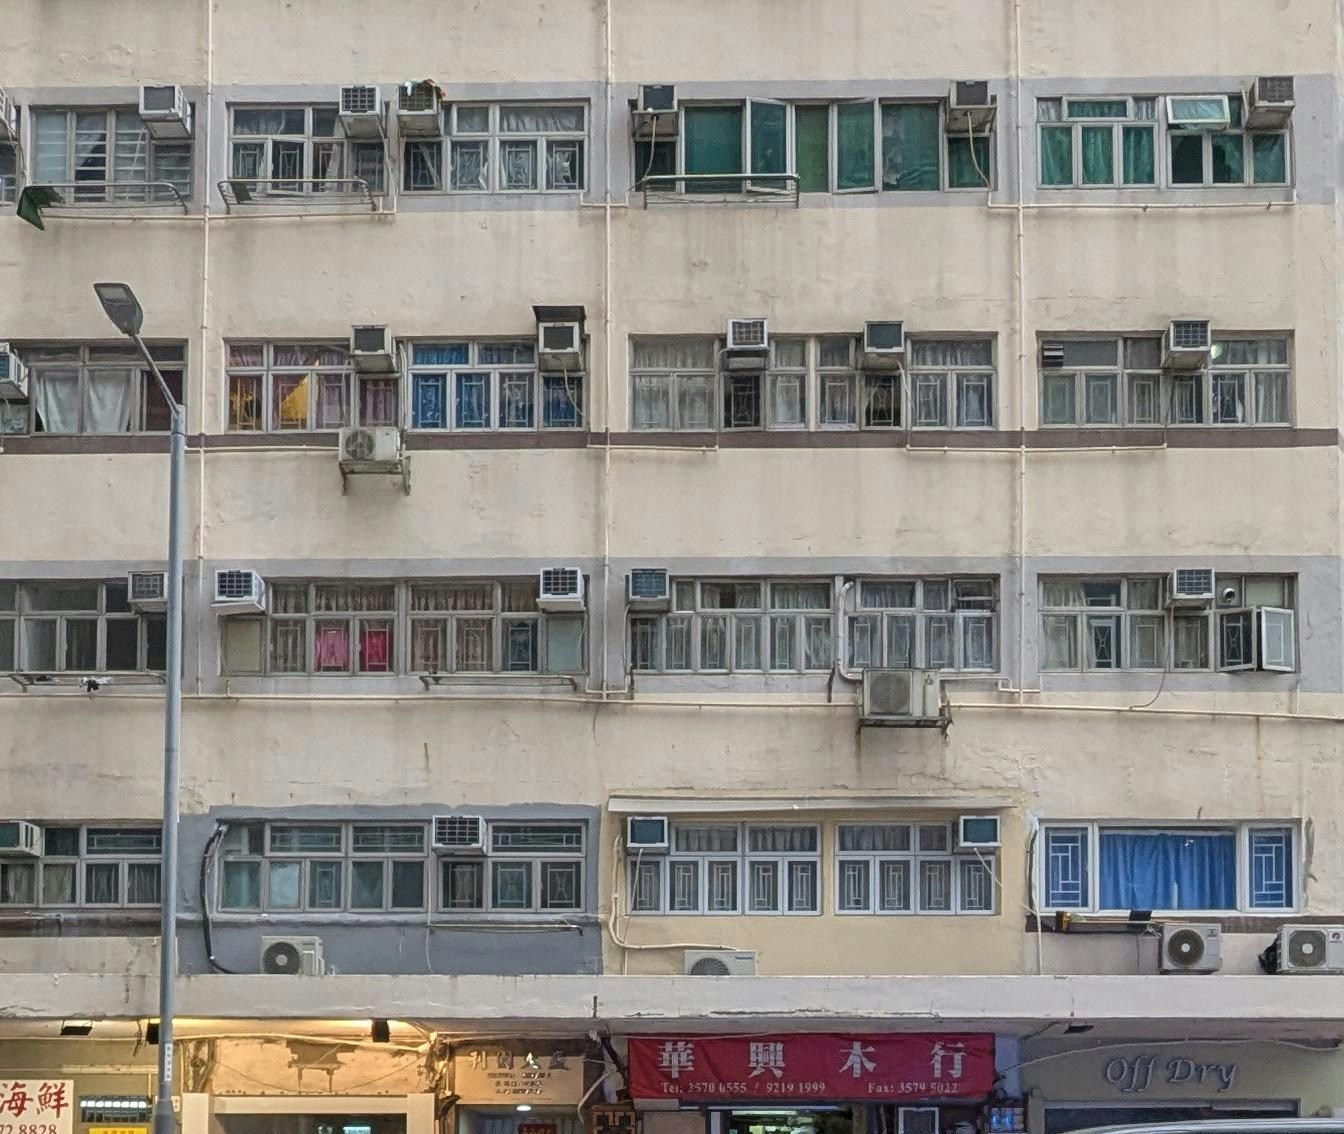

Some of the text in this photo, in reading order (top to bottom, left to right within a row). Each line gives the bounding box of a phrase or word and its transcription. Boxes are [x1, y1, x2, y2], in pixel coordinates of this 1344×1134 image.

[658, 1041, 967, 1078] 華興木行
[1106, 1055, 1237, 1092] Off Dry
[868, 1082, 894, 1094] Fax:
